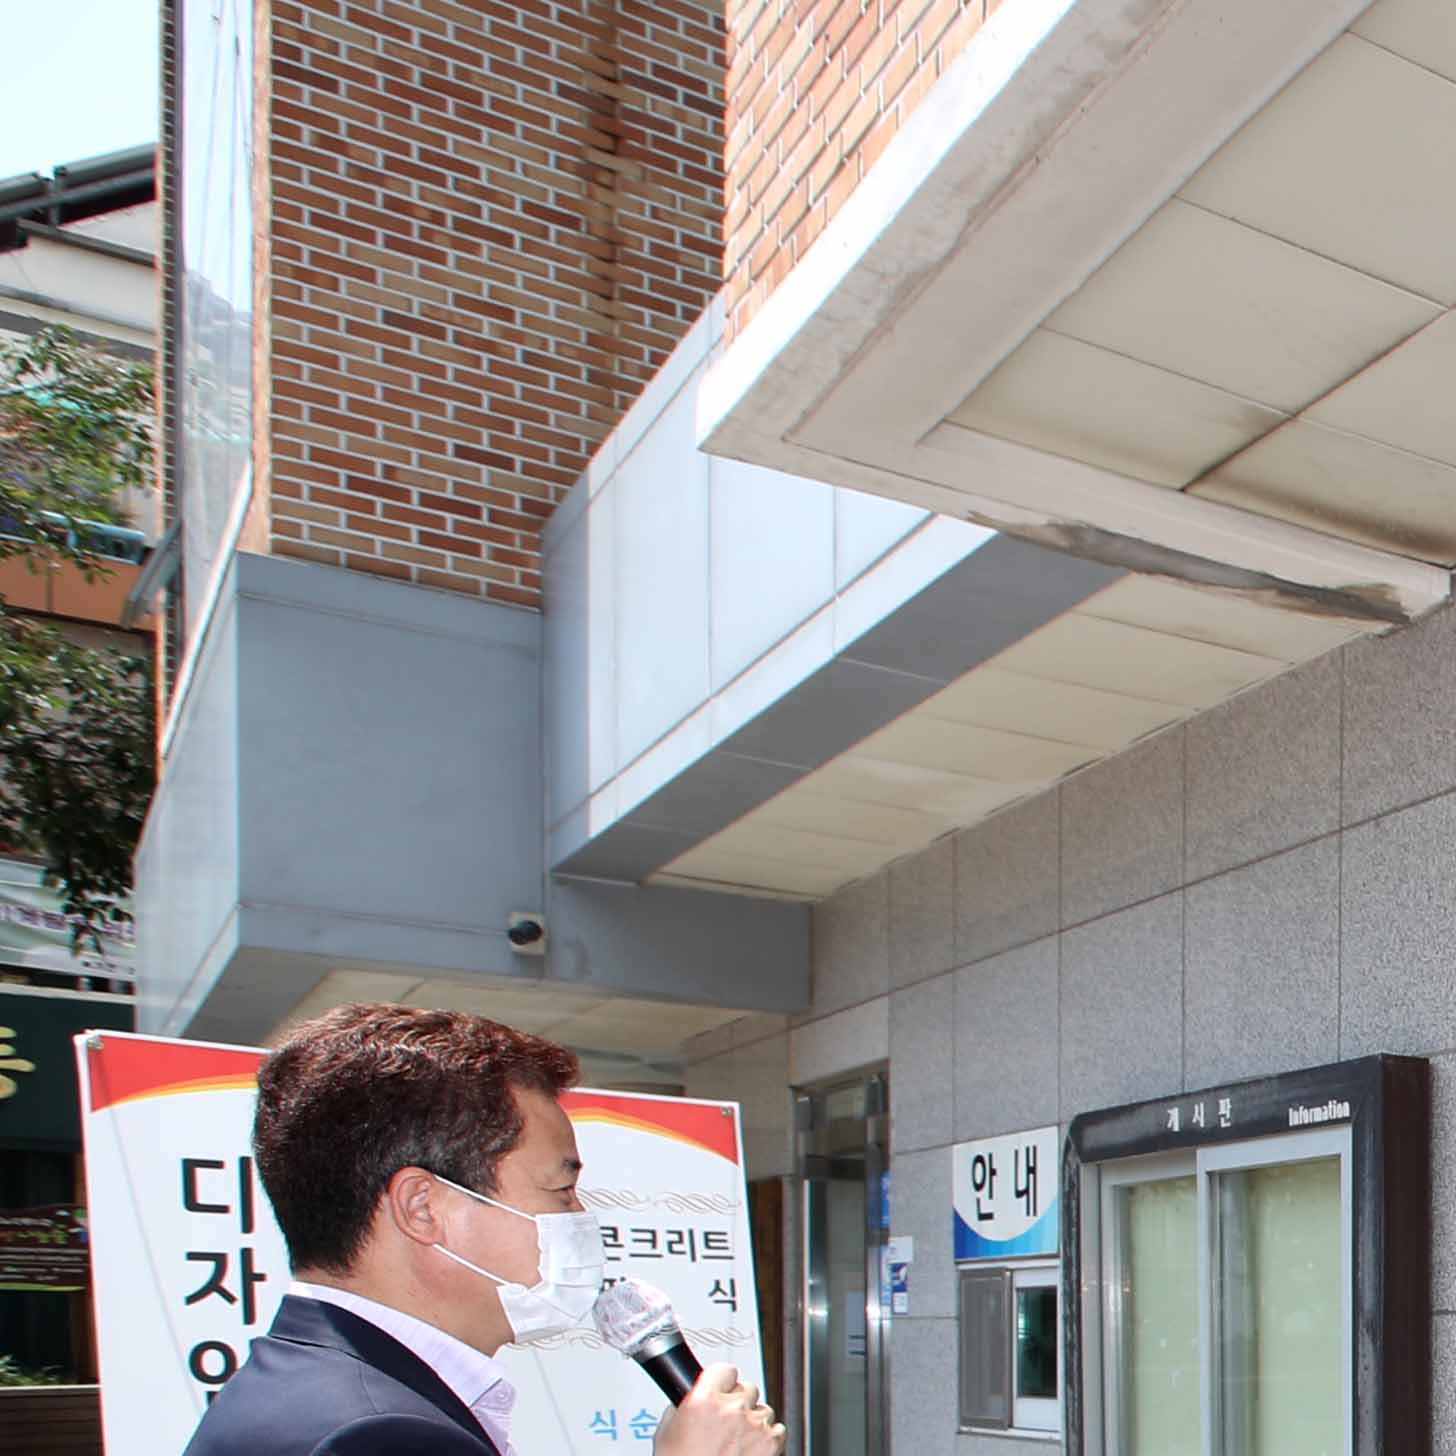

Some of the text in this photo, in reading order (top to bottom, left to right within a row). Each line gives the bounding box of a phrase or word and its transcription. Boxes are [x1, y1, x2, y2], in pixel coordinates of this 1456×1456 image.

[1289, 1099, 1351, 1127] Information
[600, 1226, 735, 1263] 콘크리트
[708, 1278, 737, 1312] 식
